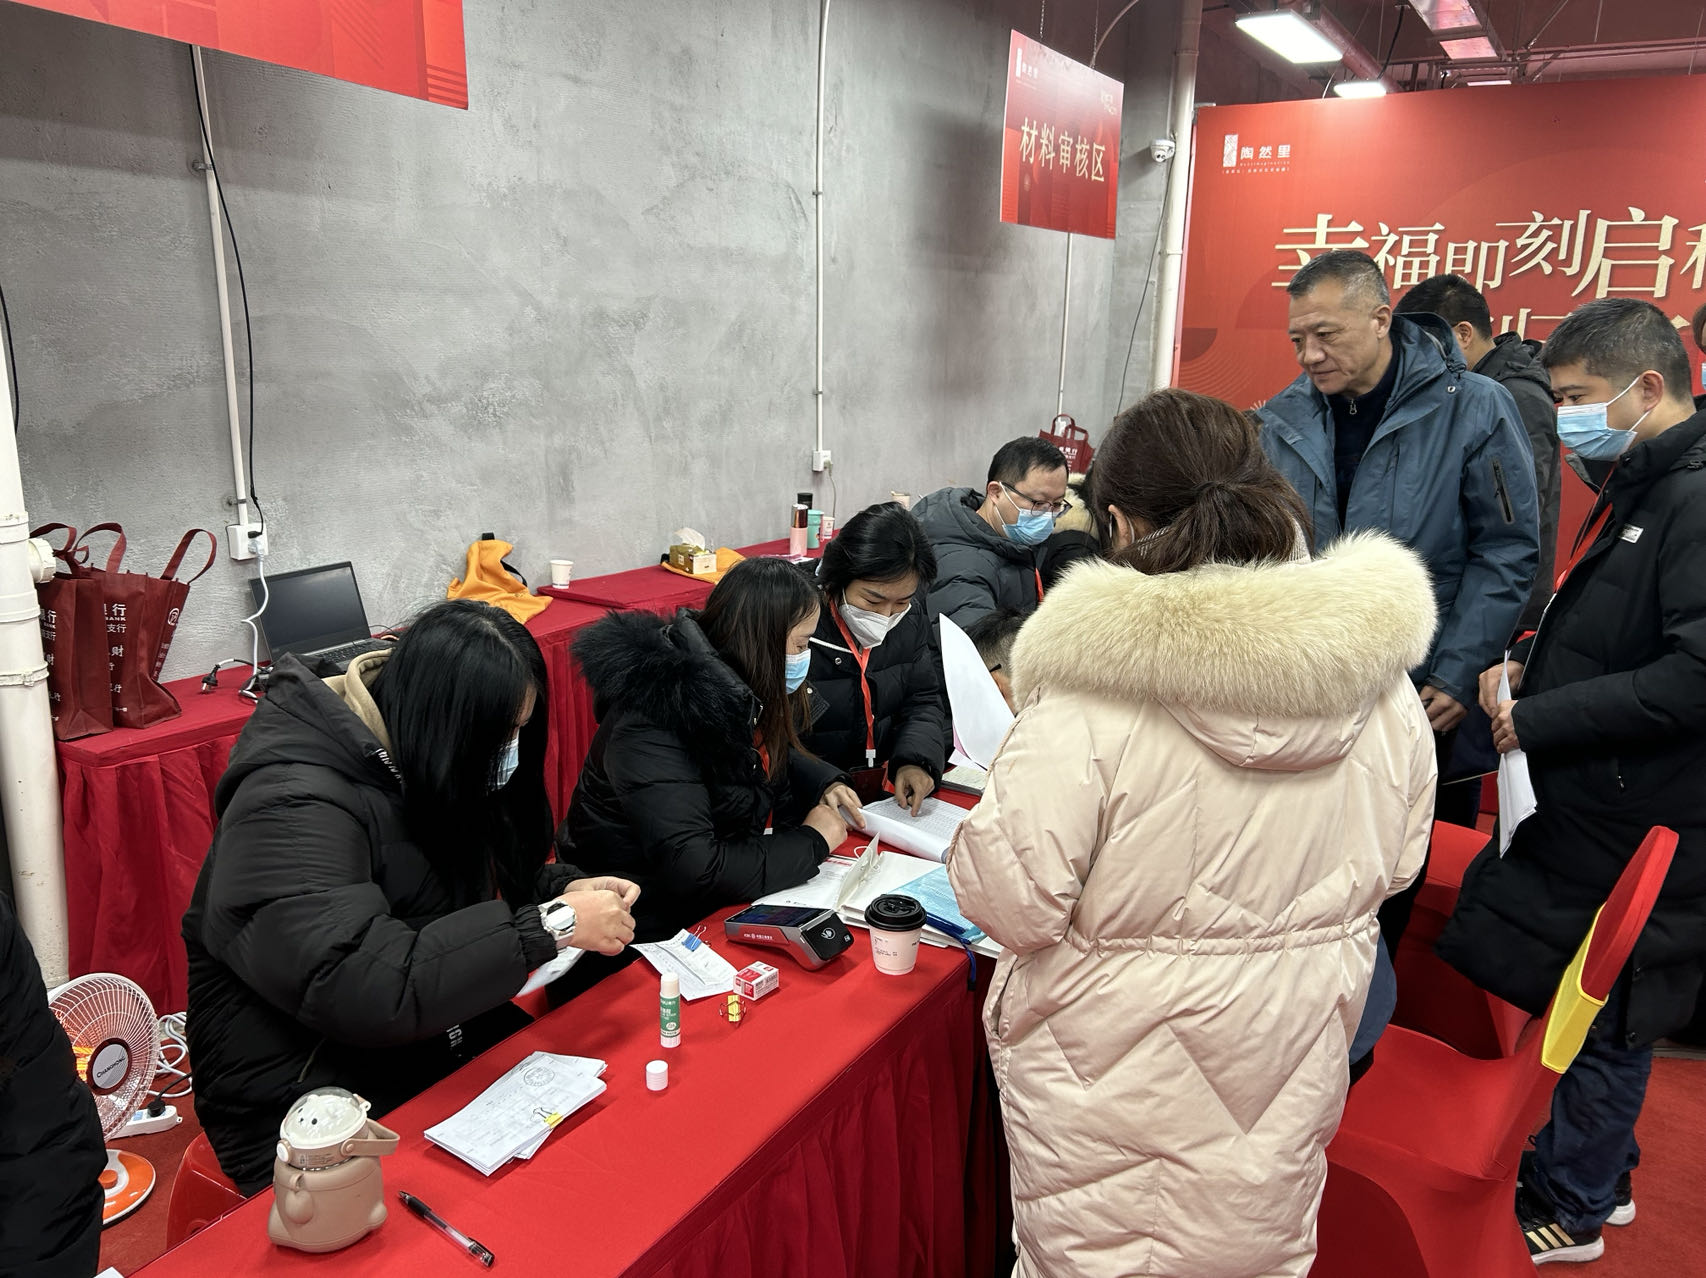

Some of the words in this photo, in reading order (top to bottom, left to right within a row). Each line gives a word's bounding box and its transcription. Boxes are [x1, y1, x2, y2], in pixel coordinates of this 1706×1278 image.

[1019, 116, 1106, 183] 材料审核区
[1240, 144, 1291, 160] 陶然里
[1271, 206, 1706, 299] 幸福即刻启
